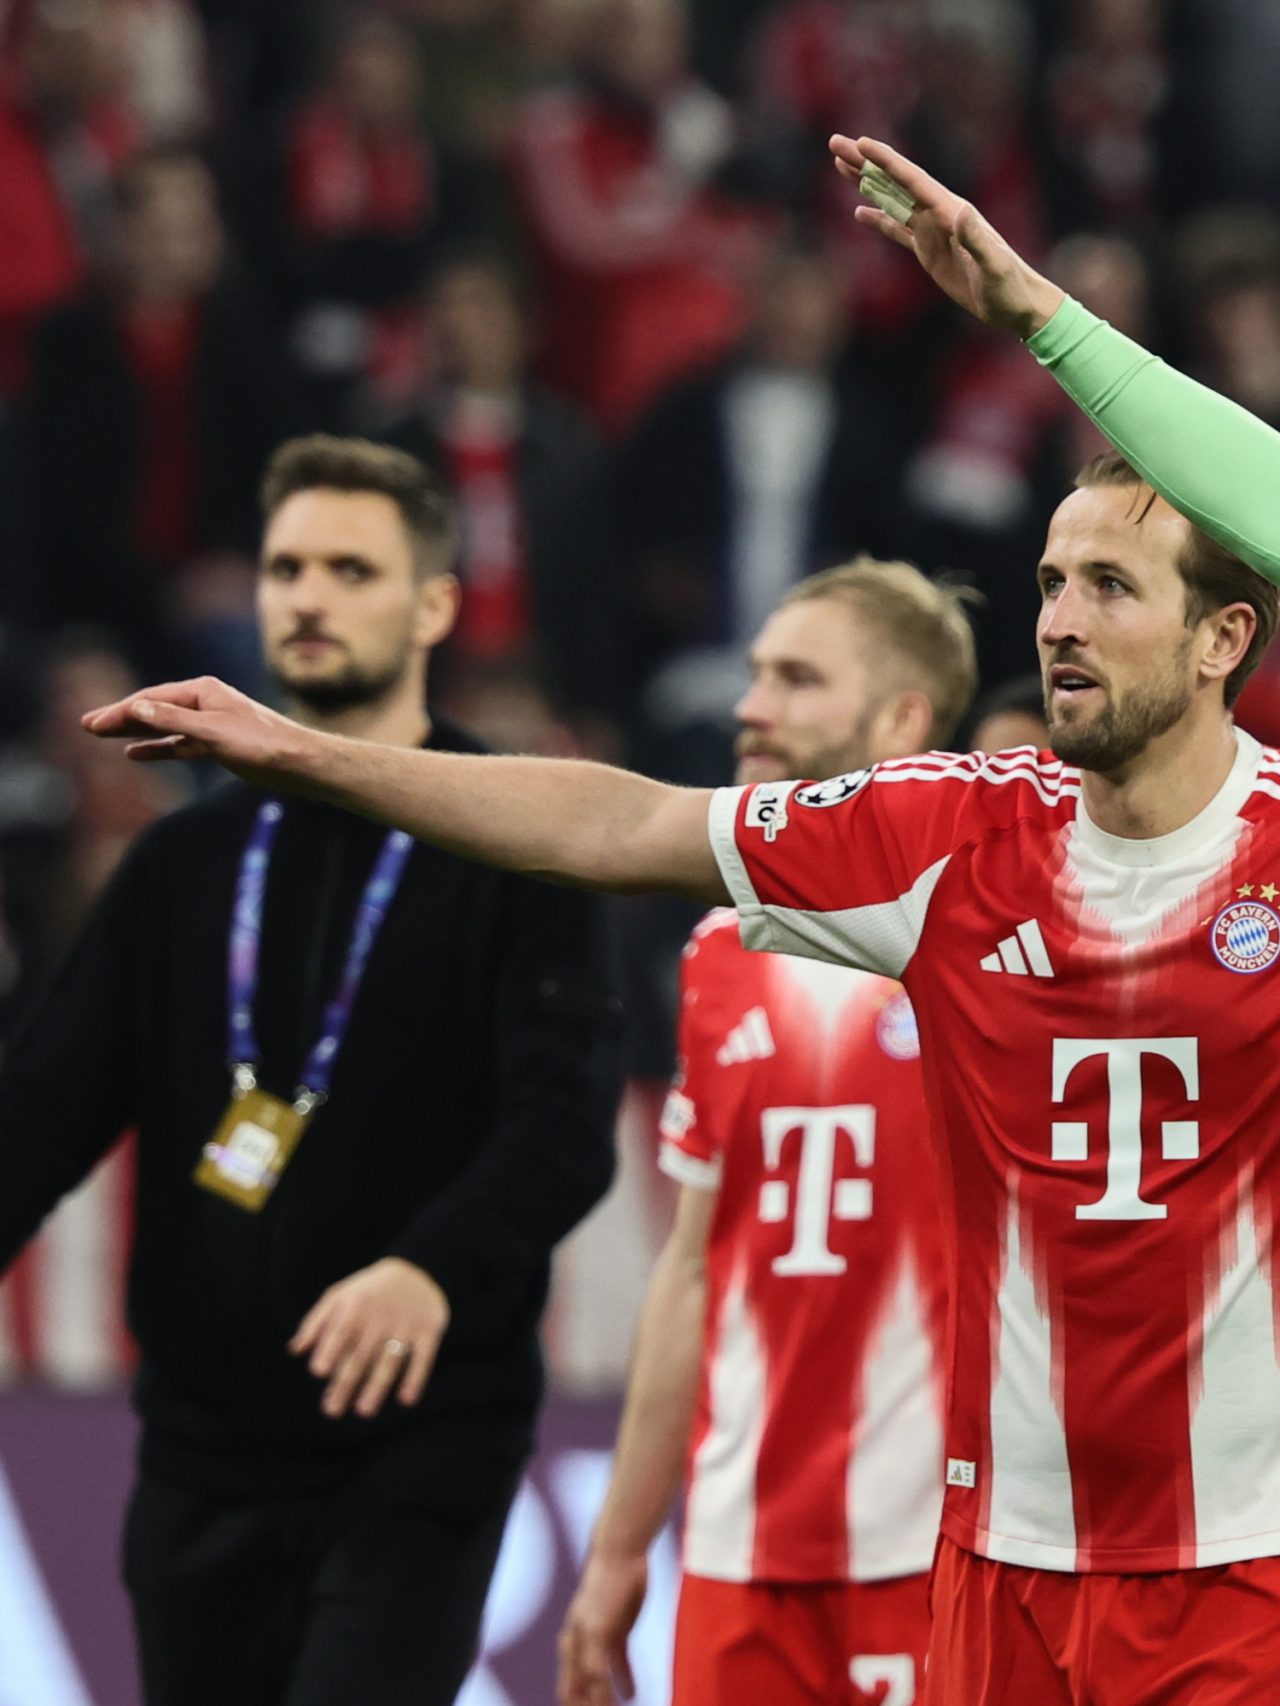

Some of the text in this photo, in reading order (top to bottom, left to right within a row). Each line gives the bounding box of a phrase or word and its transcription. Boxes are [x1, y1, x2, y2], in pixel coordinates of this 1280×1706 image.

[1217, 906, 1278, 935] FC BAYERN
[758, 1104, 876, 1277] T
[1051, 1037, 1199, 1220] T
